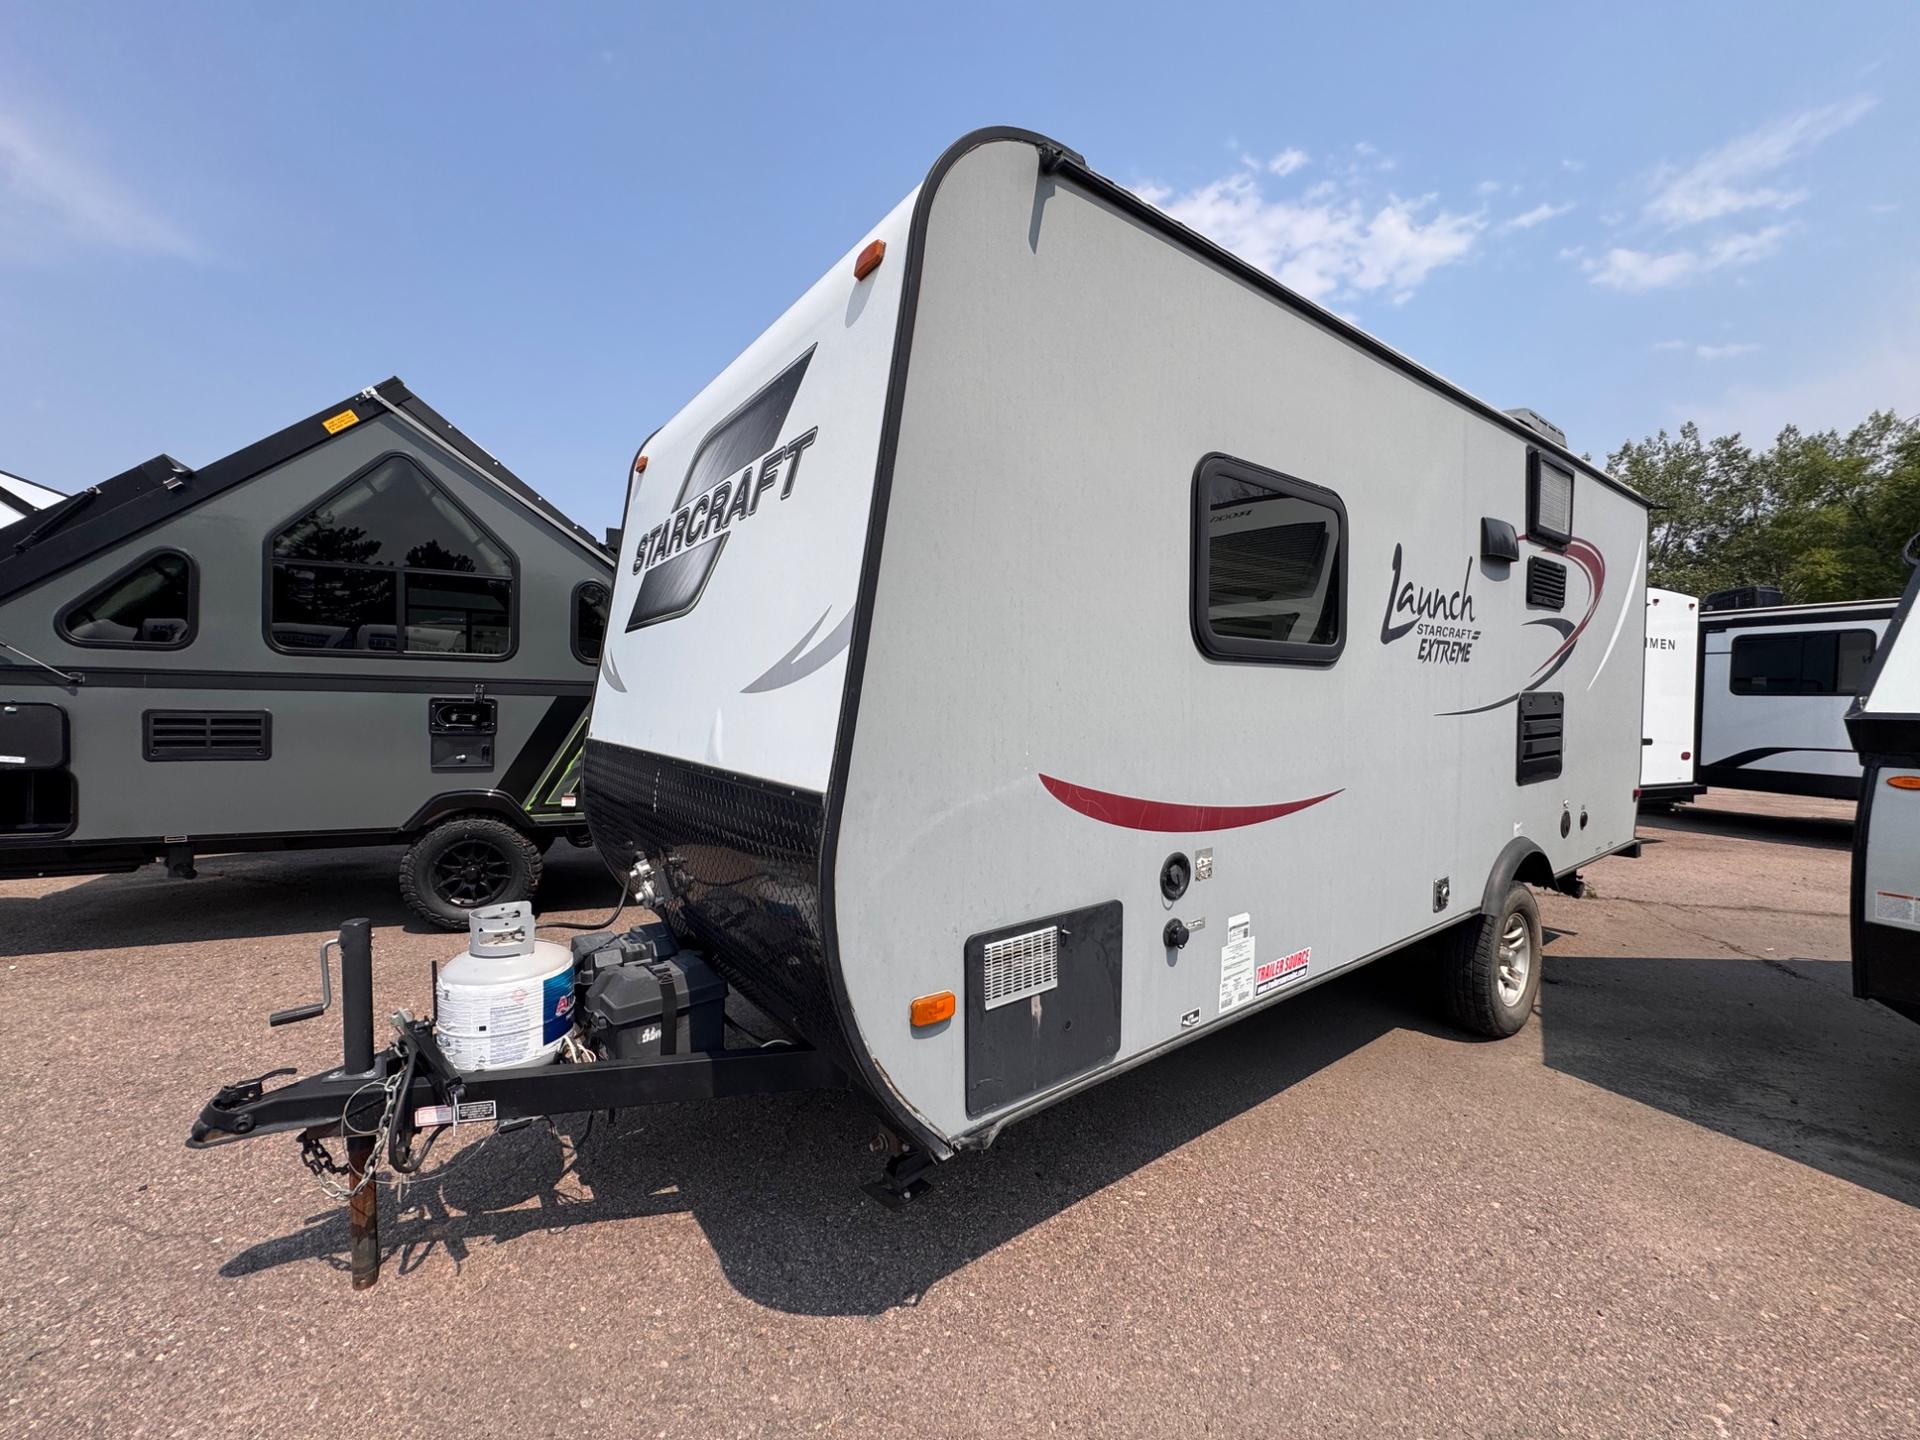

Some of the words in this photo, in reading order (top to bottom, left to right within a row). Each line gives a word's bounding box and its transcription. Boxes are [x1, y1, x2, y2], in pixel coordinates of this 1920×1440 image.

[632, 425, 819, 576] STARCRAFT
[1380, 542, 1476, 645] Launch
[1417, 623, 1473, 641] STARCRAFT
[1417, 638, 1473, 665] EXTREME
[1256, 958, 1285, 983] TRAILER
[1284, 948, 1310, 972] SOURCE
